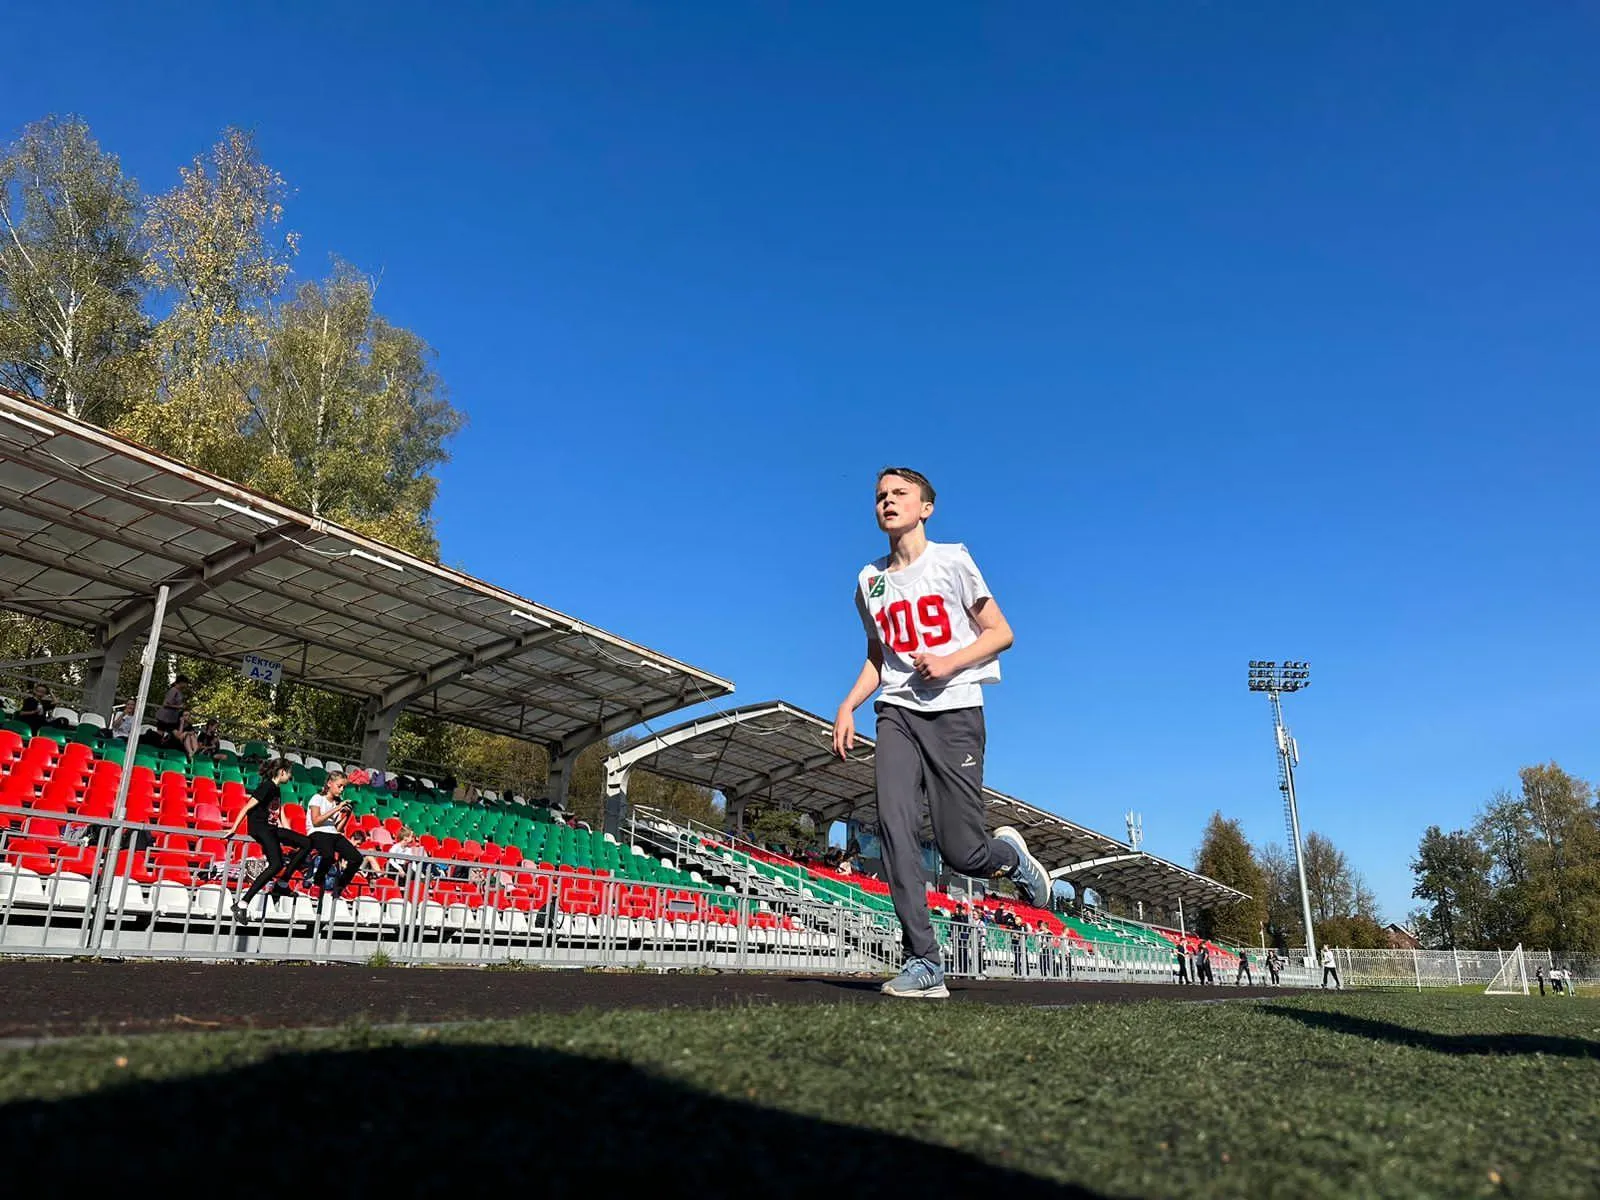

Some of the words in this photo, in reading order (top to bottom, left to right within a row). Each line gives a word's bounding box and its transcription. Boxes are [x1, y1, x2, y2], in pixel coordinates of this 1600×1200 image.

[875, 594, 952, 653] 109
[245, 655, 281, 670] СЕКТОР
[250, 666, 273, 681] А-2
